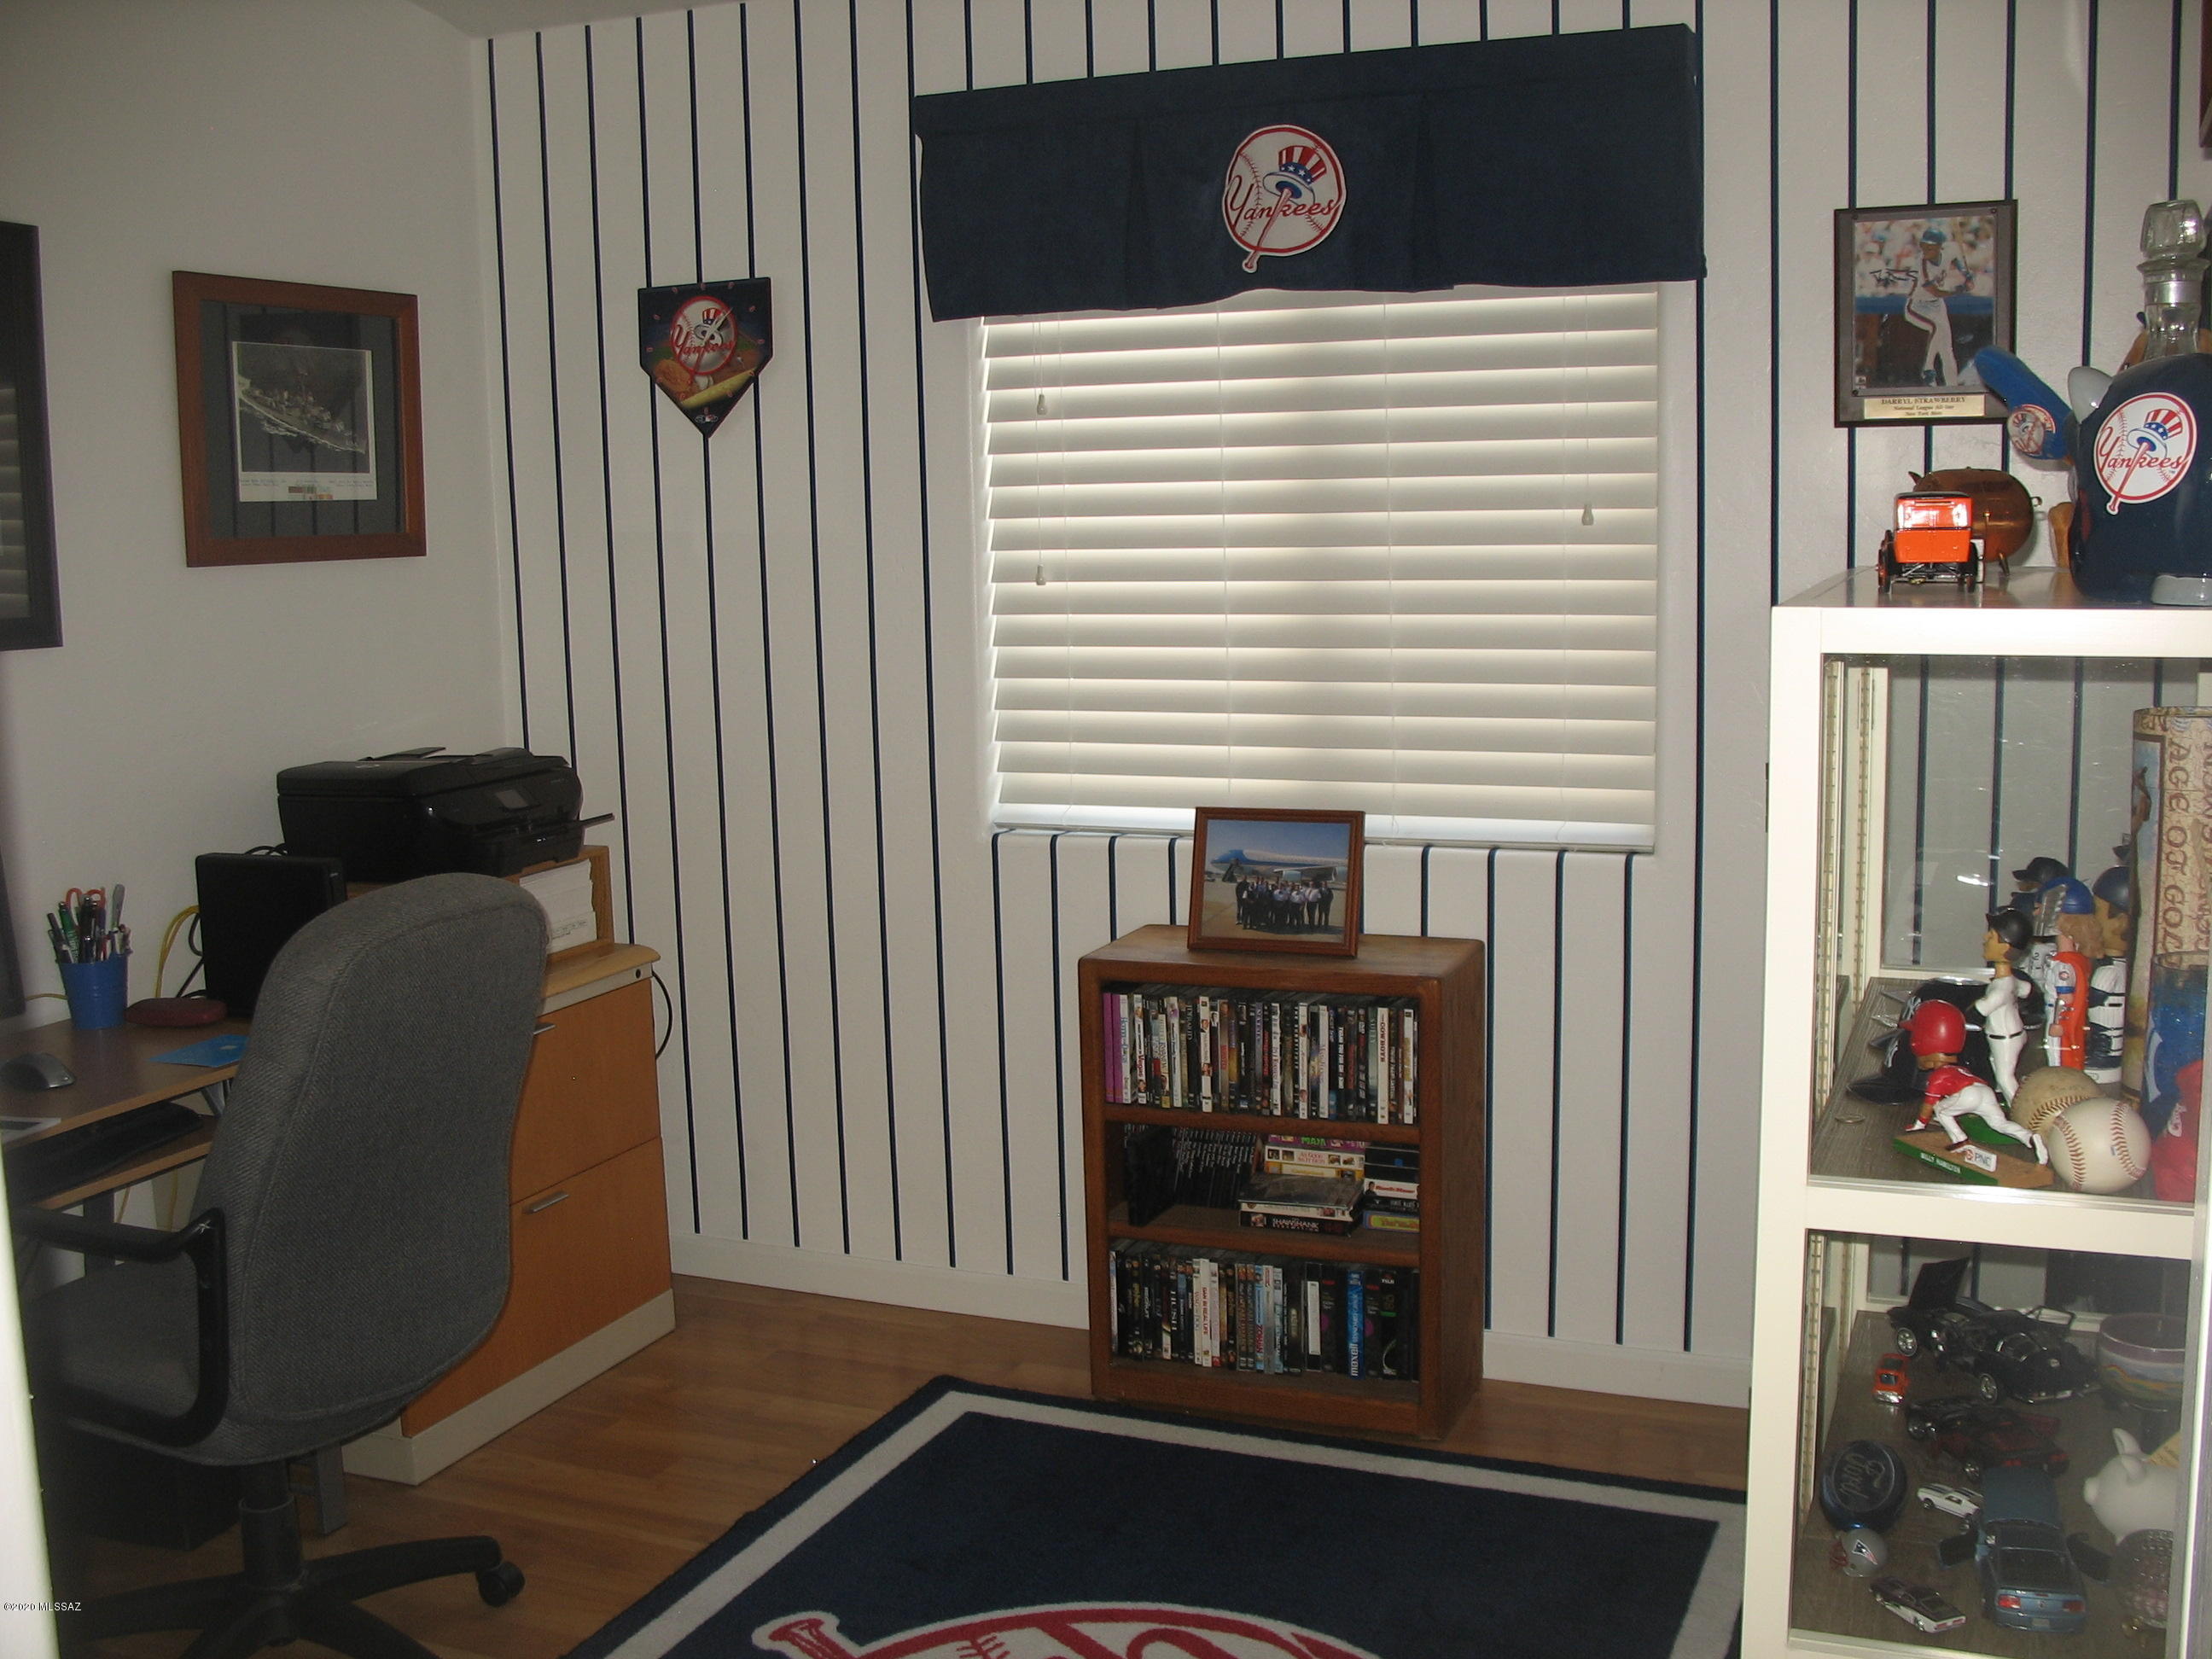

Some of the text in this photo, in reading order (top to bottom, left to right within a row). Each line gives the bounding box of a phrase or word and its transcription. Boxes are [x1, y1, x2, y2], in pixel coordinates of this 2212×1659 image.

[1226, 174, 1336, 229] Yankees
[1914, 396, 1965, 405] STRAWBERRY
[2099, 426, 2184, 474] Yankees
[1350, 1343, 1359, 1377] maxell
